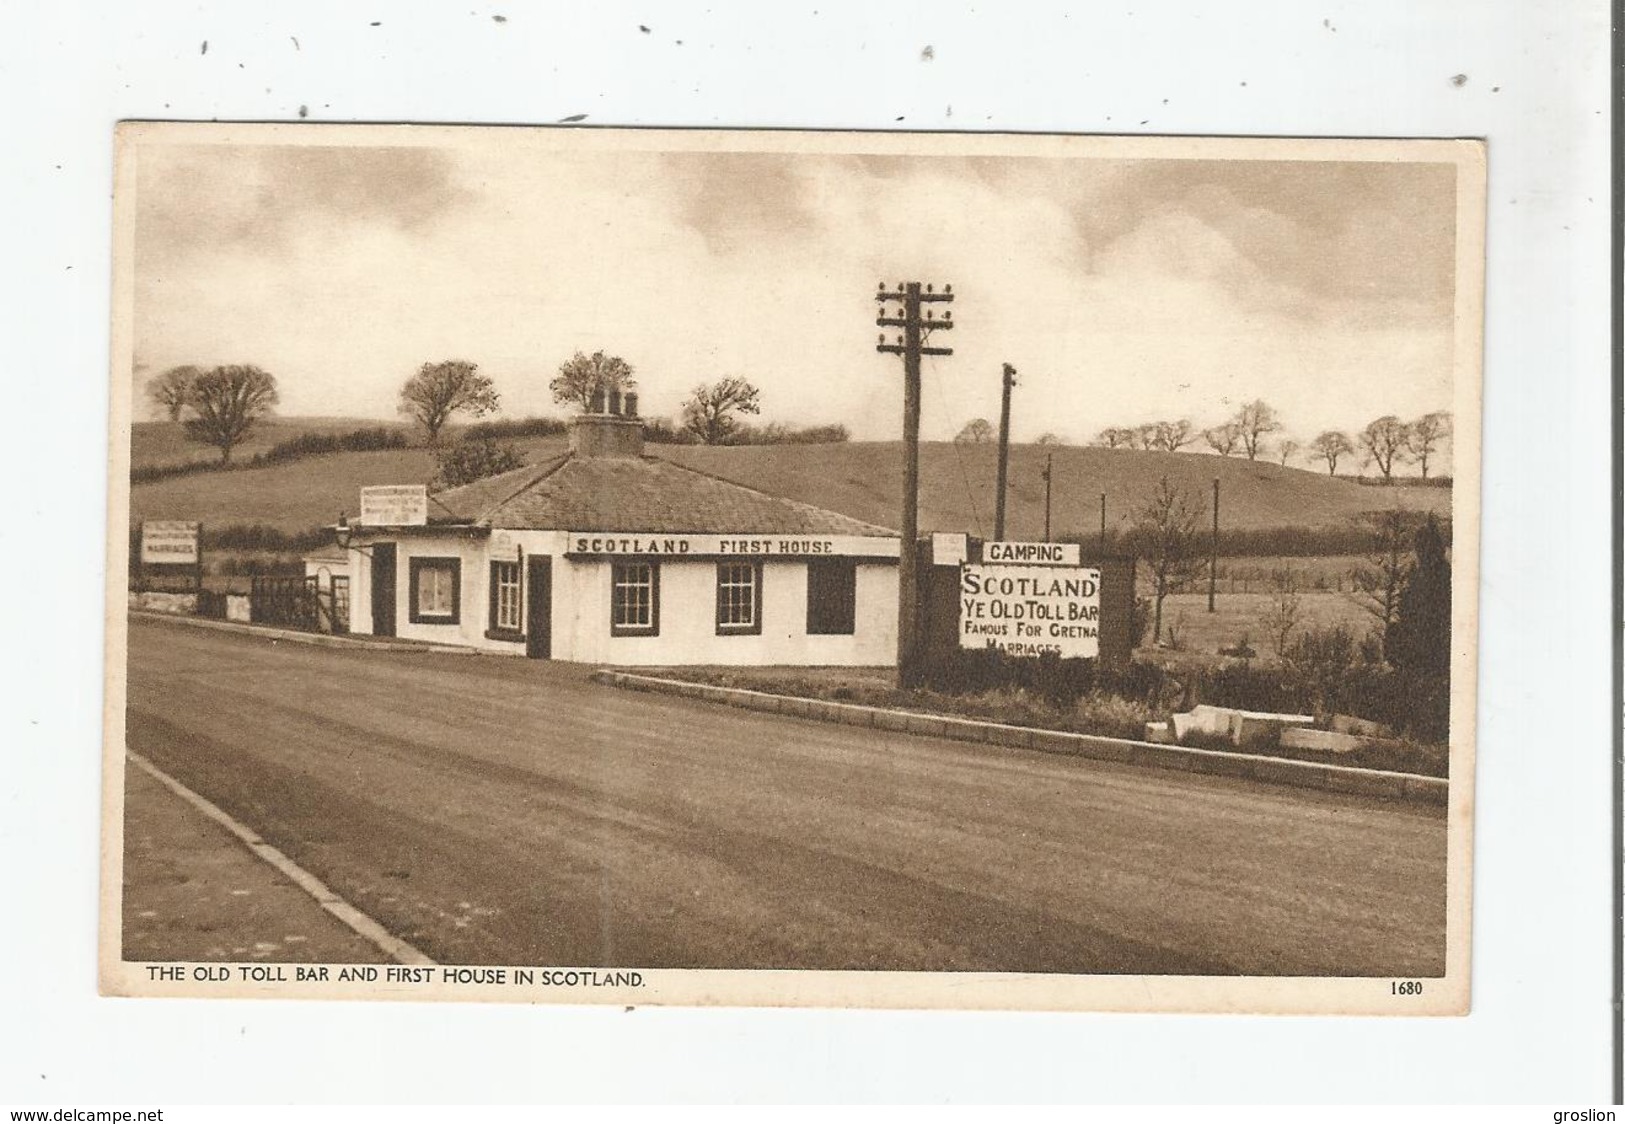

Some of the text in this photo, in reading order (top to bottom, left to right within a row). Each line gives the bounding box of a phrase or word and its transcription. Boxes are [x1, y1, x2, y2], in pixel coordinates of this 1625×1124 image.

[577, 538, 833, 554] SCOTLAND FIRST HOUSE
[990, 544, 1063, 561] CAMPING
[963, 567, 1099, 598] "SCOTLAND"
[146, 966, 647, 988] THE OLD TOLL BAR AND FIRST HOUSE IN SCOTLAND.
[1391, 981, 1423, 995] 1680
